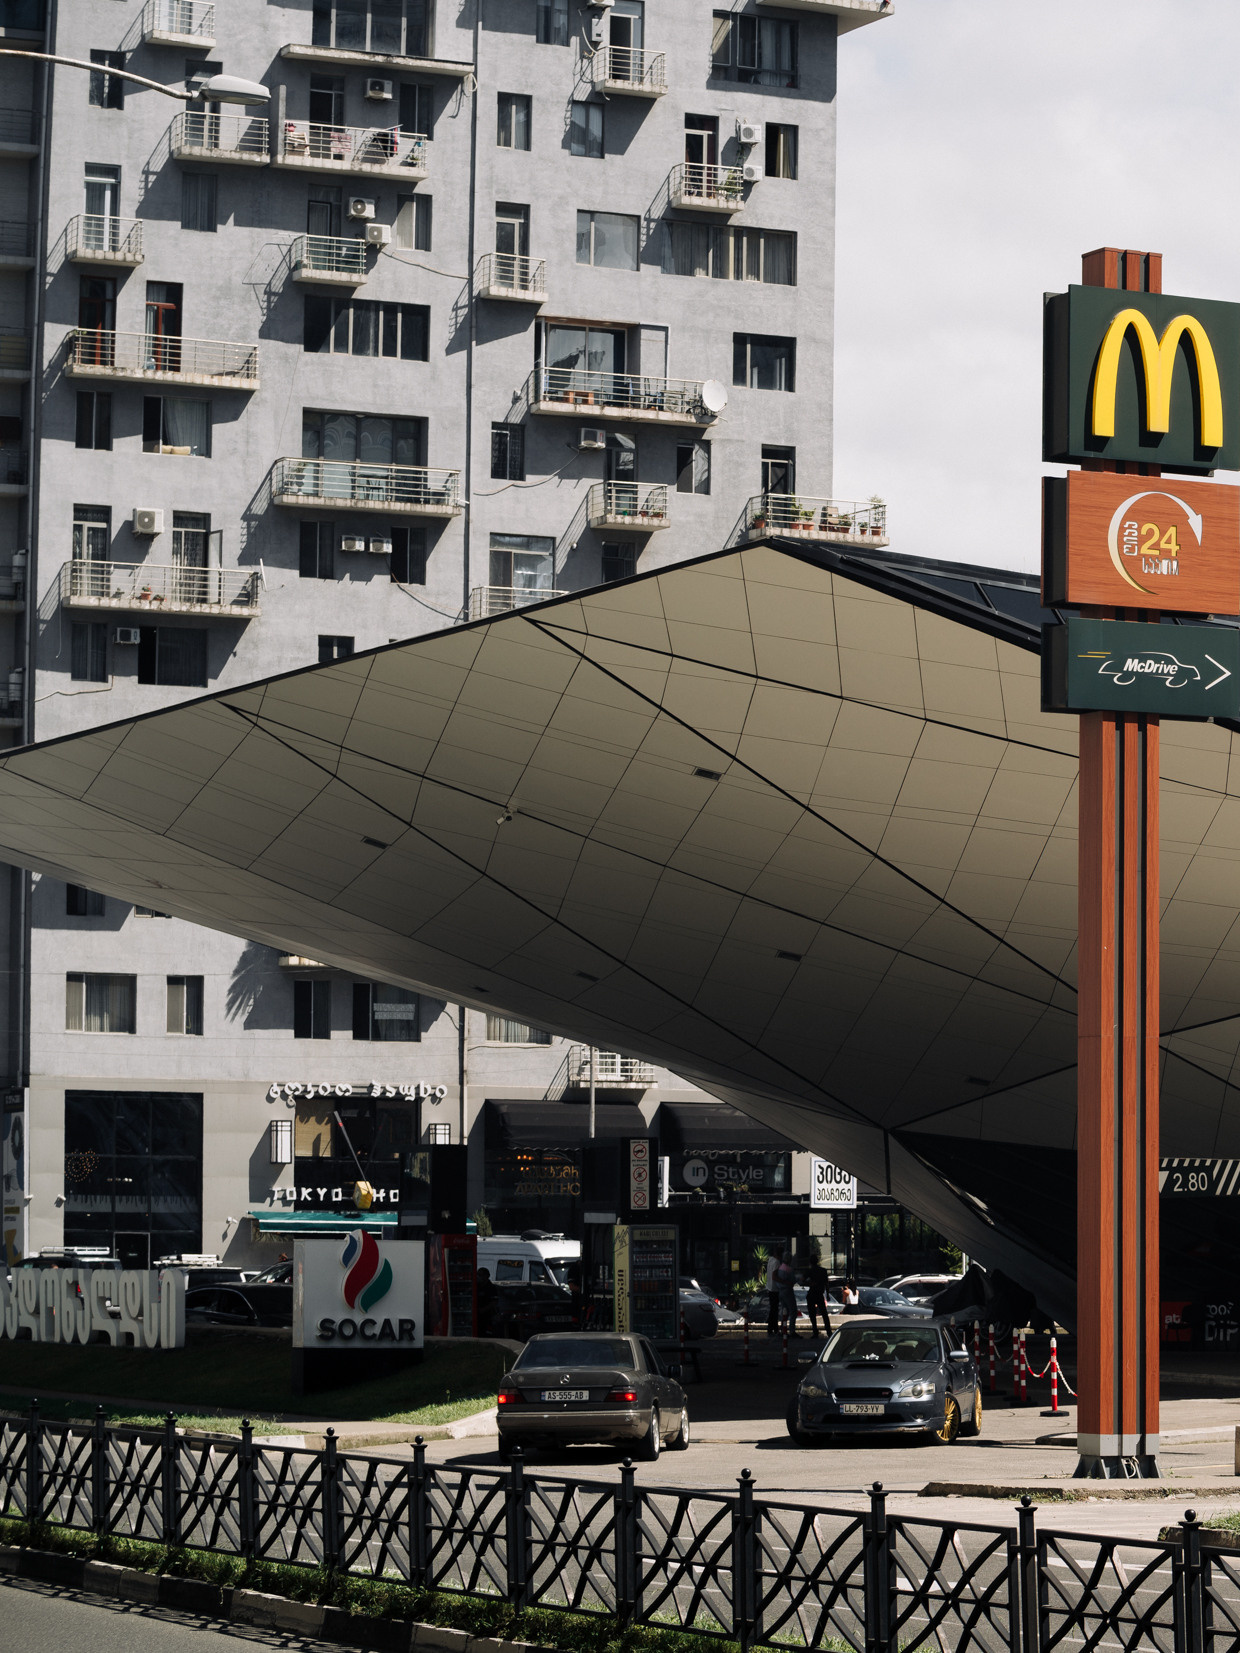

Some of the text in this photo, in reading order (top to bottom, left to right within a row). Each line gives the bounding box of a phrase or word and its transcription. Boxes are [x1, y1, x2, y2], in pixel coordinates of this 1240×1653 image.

[1140, 523, 1181, 557] 24
[1123, 658, 1178, 675] McDrive
[714, 1165, 763, 1182] Style
[1173, 1173, 1208, 1191] 2.80
[270, 1187, 342, 1201] TOKYO
[817, 1188, 852, 1201] პიაჩერე
[0, 1267, 177, 1349] კდონალდსი
[318, 1317, 416, 1341] SOCAR
[547, 1391, 584, 1400] AS-555-AB
[844, 1405, 880, 1413] LL-793-YY
